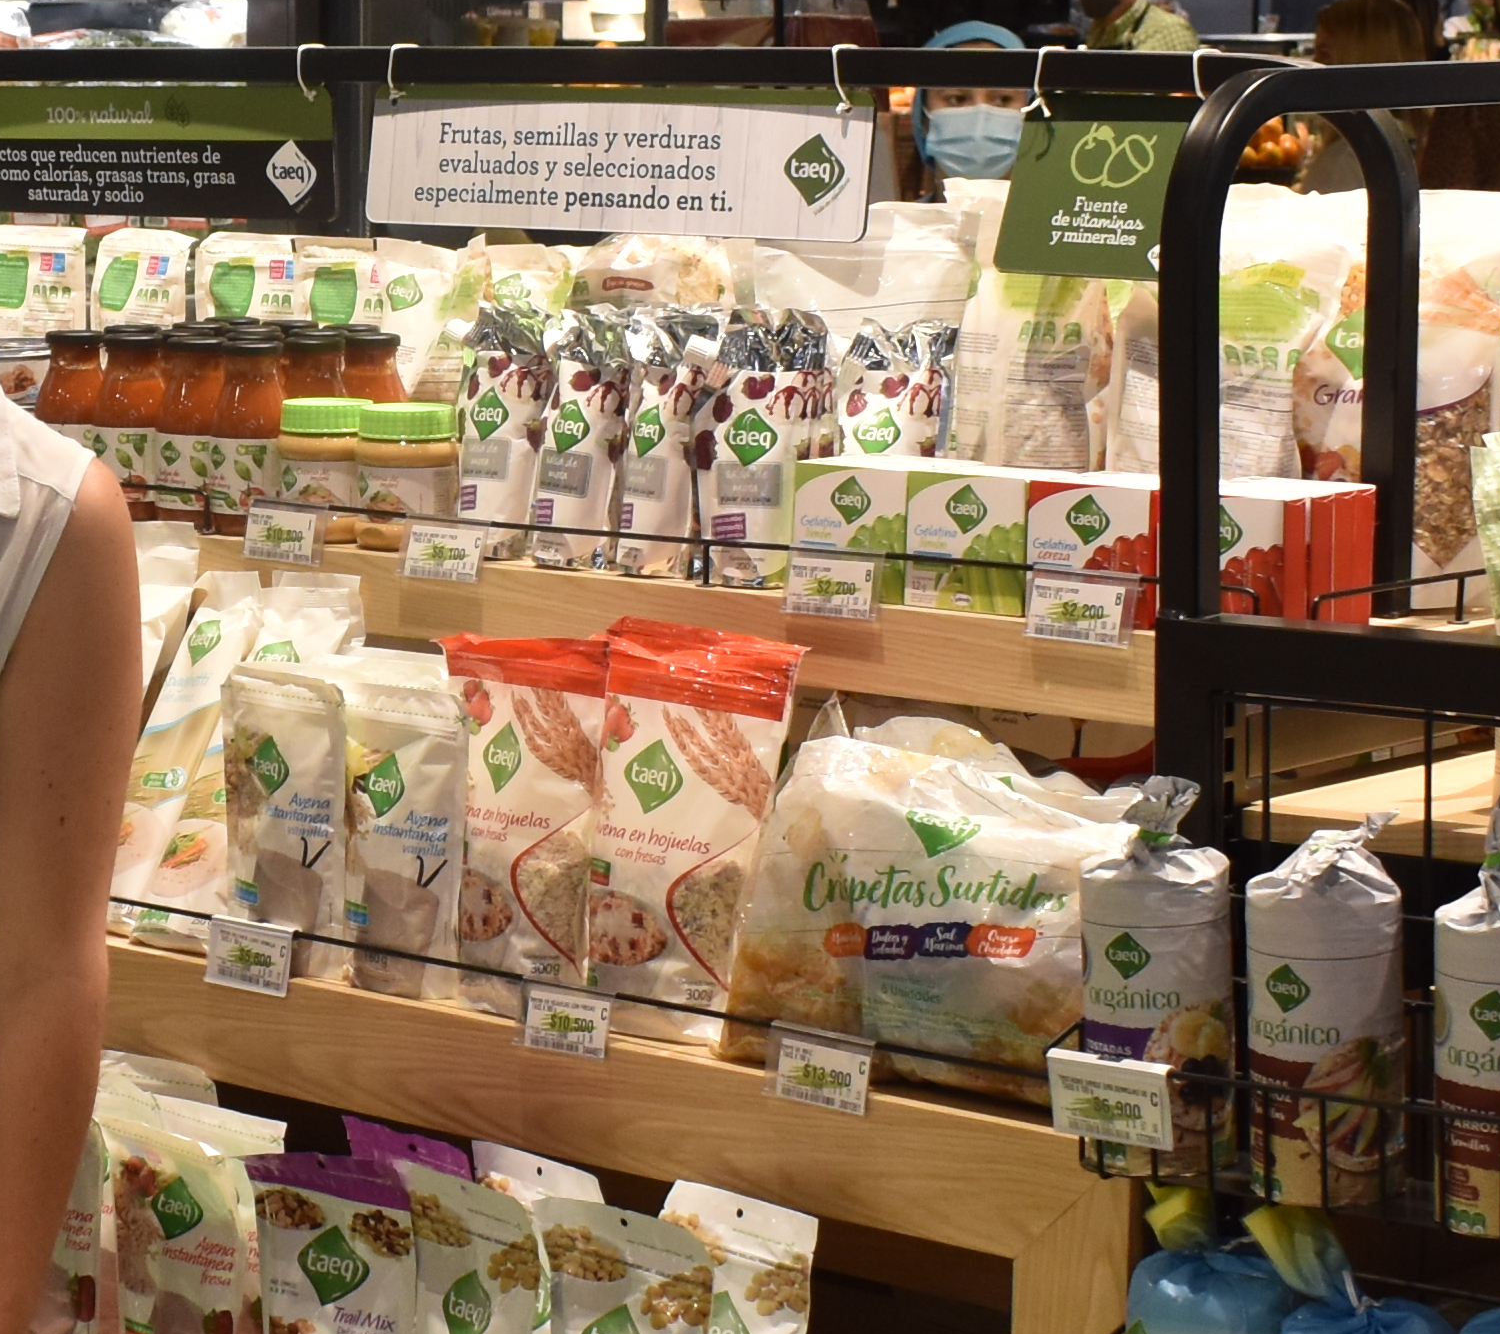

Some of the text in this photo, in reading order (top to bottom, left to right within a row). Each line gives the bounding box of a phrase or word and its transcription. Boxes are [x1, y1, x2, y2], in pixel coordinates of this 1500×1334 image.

[46, 100, 154, 125] 100% natural
[438, 121, 721, 153] Frutas, semillas y verduras
[30, 147, 57, 167] que
[59, 145, 118, 164] reducen
[121, 146, 199, 165] nutrientes
[202, 147, 221, 165] de
[438, 152, 716, 182] evaluados y seleccionados
[33, 163, 94, 186] calorías,
[96, 169, 145, 186] grasas
[147, 168, 190, 188] trans,
[193, 170, 236, 188] grasa
[27, 185, 145, 207] saturada y sodio
[413, 183, 733, 213] especialmente pensando en ti.
[1072, 195, 1129, 215] Fuente
[1050, 210, 1145, 231] de vitaminas
[1049, 228, 1137, 247] y minerales
[471, 404, 504, 426] taeq
[552, 416, 586, 440] taeq
[728, 426, 773, 450] taeq
[832, 490, 863, 510] taeq
[947, 498, 980, 519] taeq
[800, 514, 842, 530] Gelatina
[1069, 509, 1102, 530] taeq
[913, 523, 958, 542] Gelatina
[1032, 536, 1078, 554] Gelatina
[1036, 550, 1071, 564] cereza
[630, 760, 668, 788] taeq
[288, 791, 331, 811] Avena
[403, 809, 448, 829] Avena
[492, 805, 551, 831] hojuelas
[628, 829, 712, 856] en hojuelas
[614, 846, 667, 866] con fresas
[802, 853, 1070, 913] Crispetas Surtidas
[934, 926, 957, 942] Sal
[987, 929, 1020, 946] Queso
[1089, 984, 1181, 1015] orgánico
[1250, 1017, 1341, 1048] orgánico
[196, 1236, 237, 1258] Avena
[306, 1249, 354, 1283] taeq
[200, 1272, 232, 1288] fresa
[334, 1305, 397, 1333] Trail Mix
